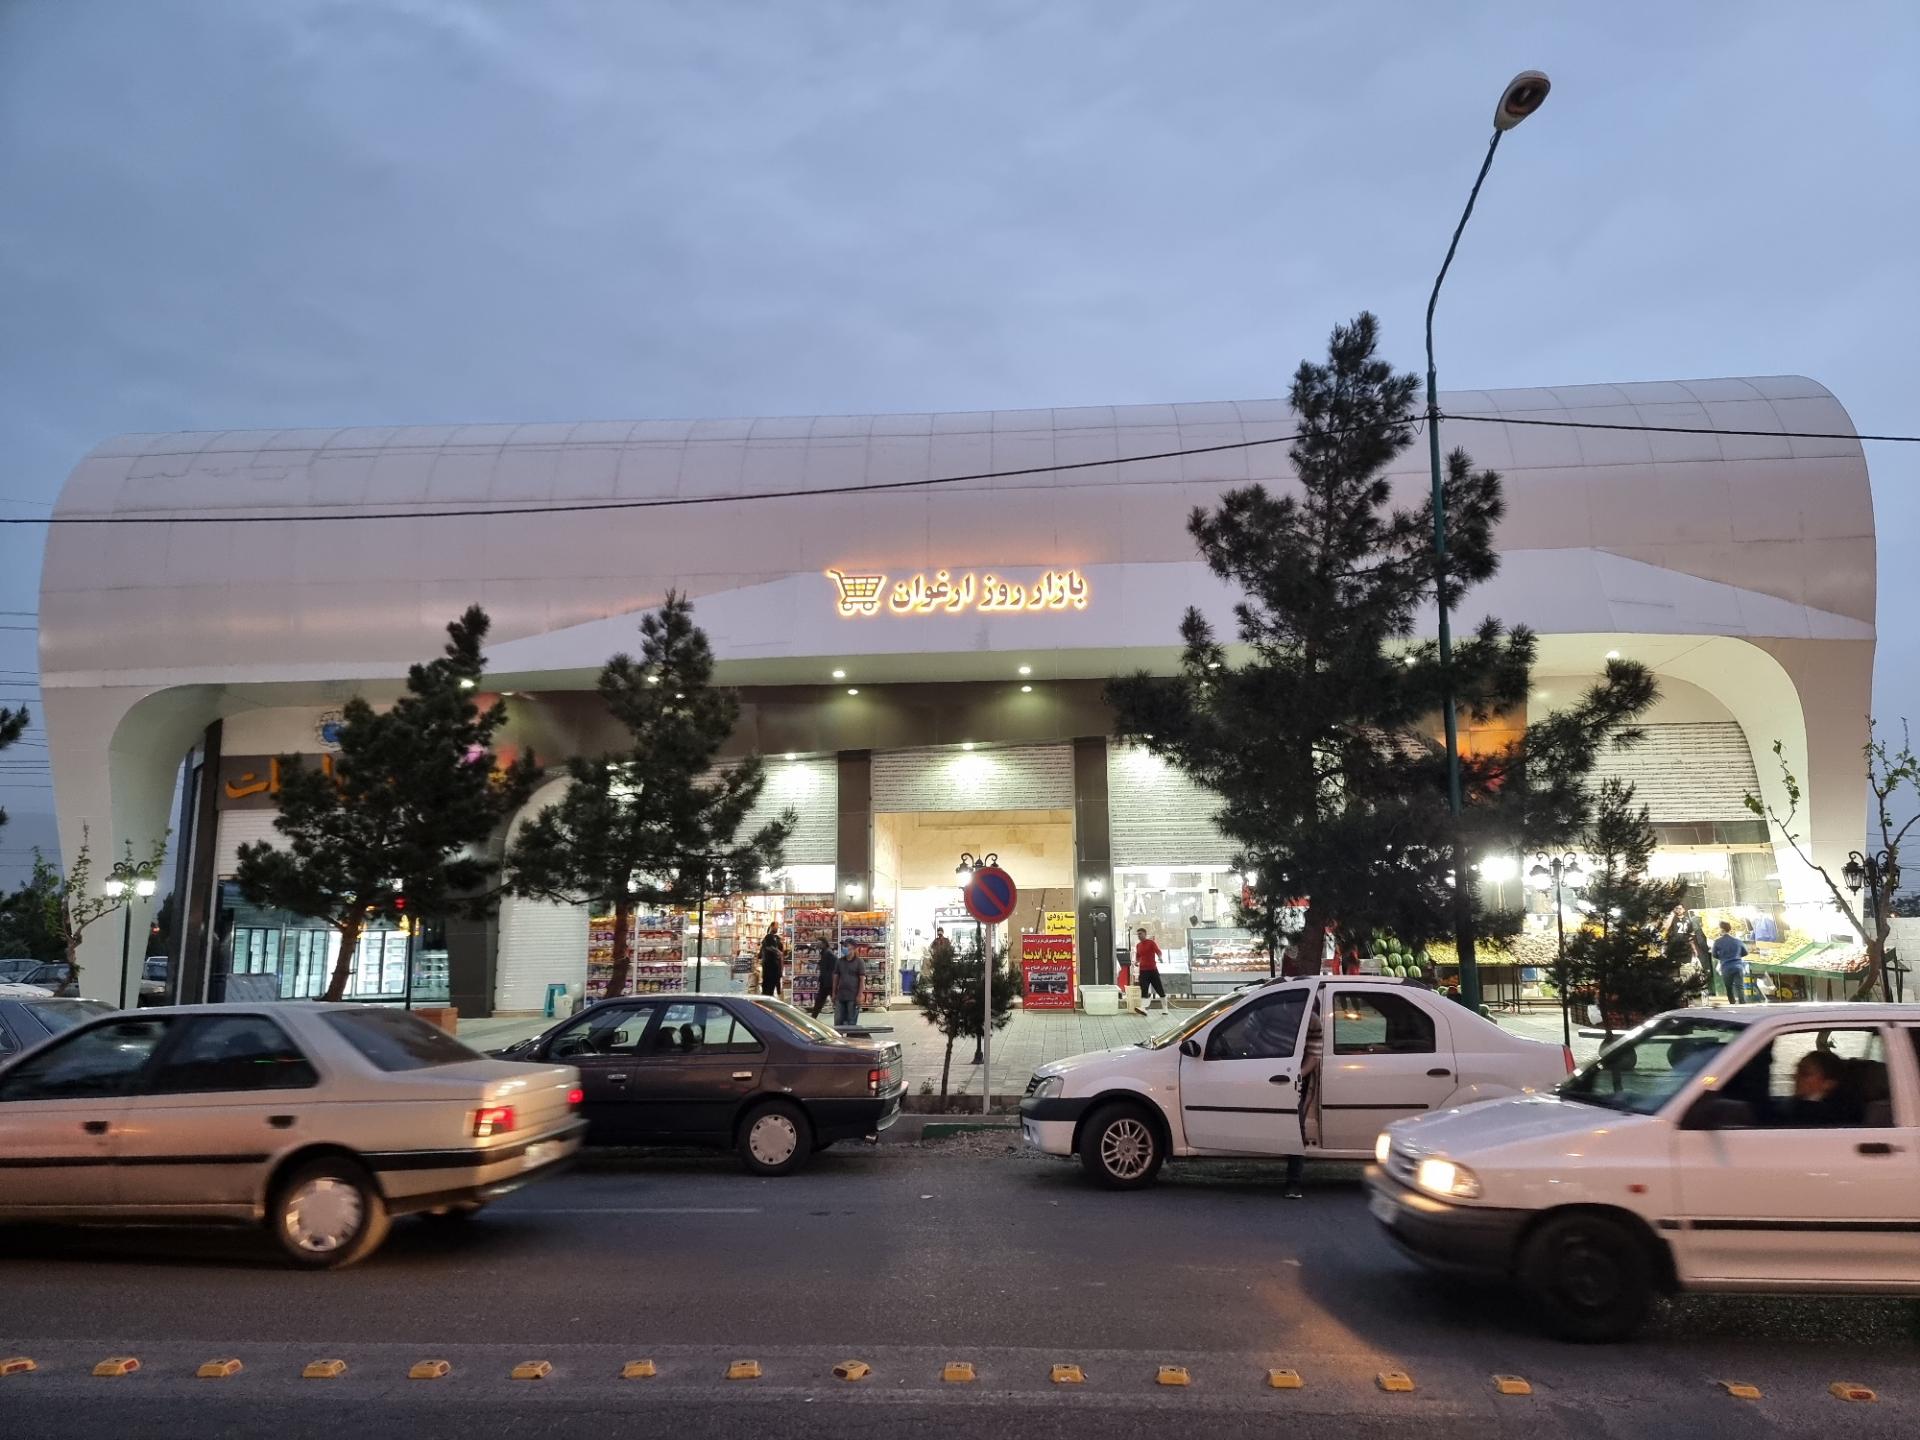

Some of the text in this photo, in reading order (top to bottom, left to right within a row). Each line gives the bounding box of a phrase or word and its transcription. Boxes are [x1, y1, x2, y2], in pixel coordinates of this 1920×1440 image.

[892, 570, 1085, 609] بازار روز ارغوان
